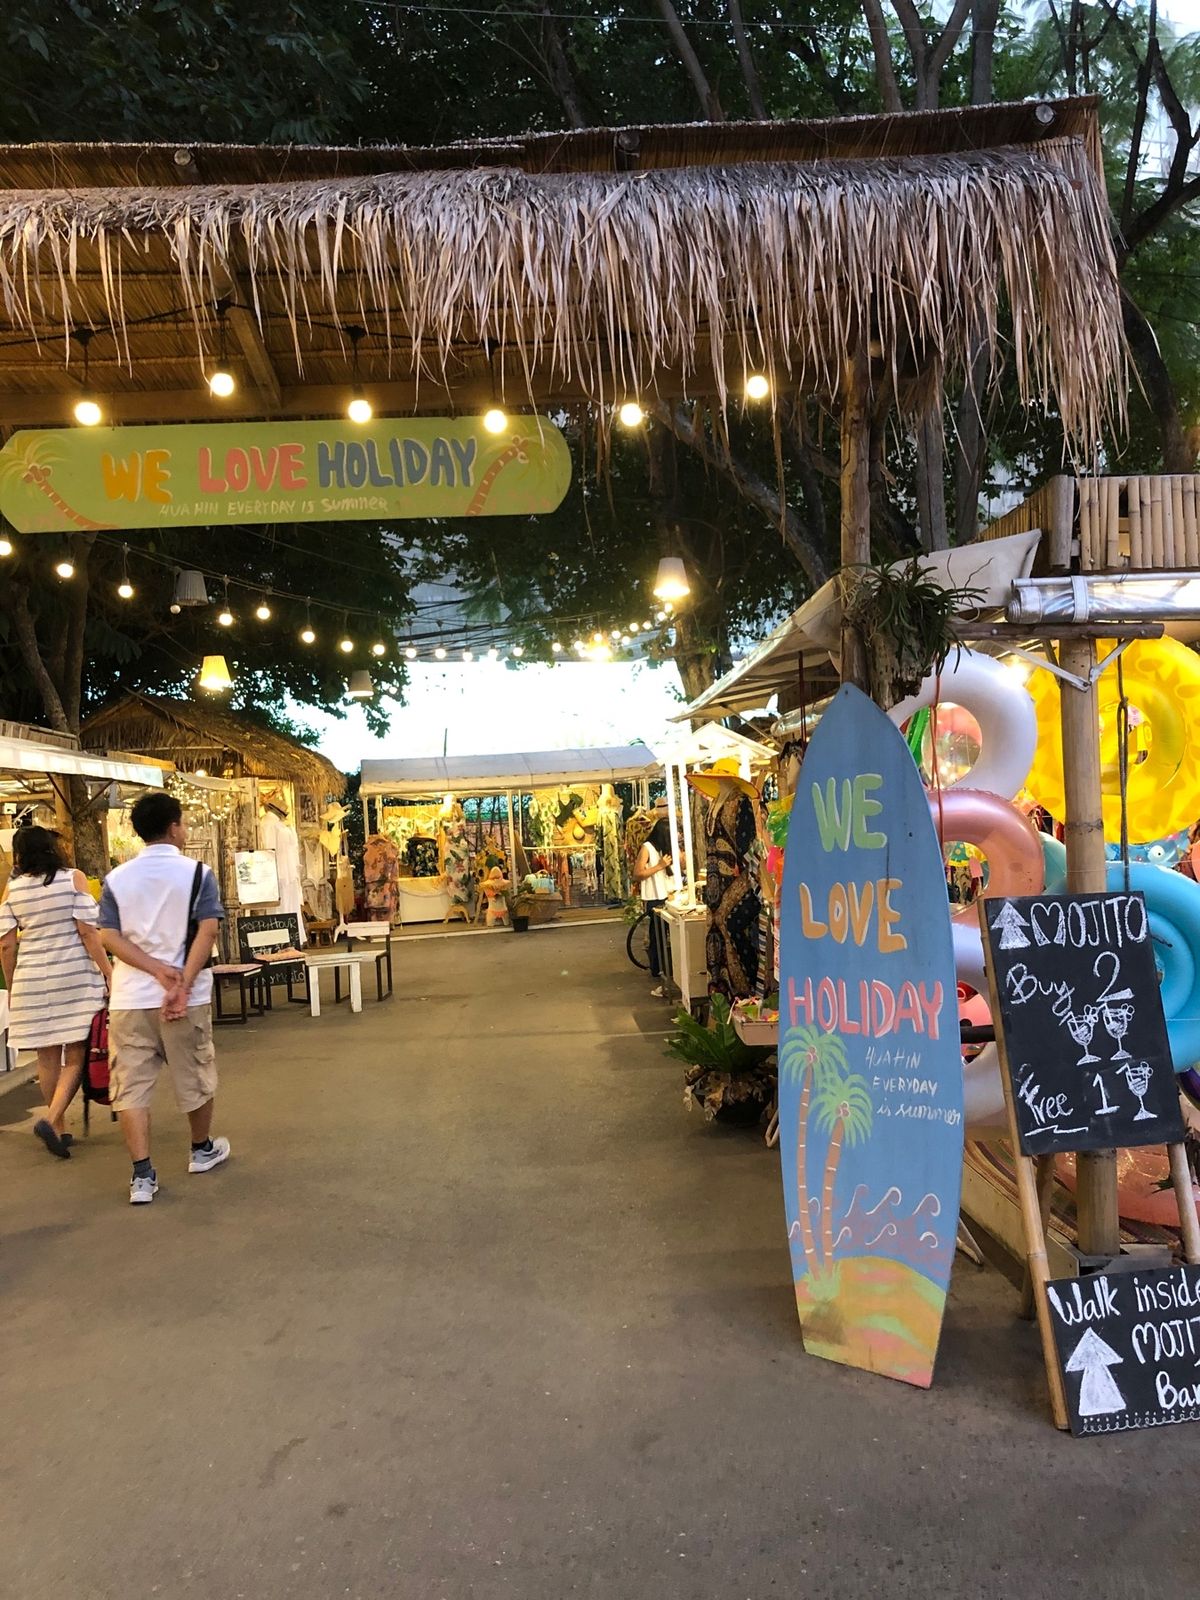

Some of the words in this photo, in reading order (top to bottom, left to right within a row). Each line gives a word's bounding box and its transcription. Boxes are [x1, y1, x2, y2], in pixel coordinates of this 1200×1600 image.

[101, 449, 173, 504] WE
[198, 443, 308, 493] LOVE
[318, 437, 477, 489] HOLIDAY
[227, 500, 295, 517] EVERYDAY
[812, 773, 887, 852] WE
[800, 878, 907, 953] LOVE
[1030, 895, 1148, 948] MOJITO
[788, 976, 943, 1040] HOLIDAY
[1006, 963, 1075, 1016] Buy
[1093, 951, 1134, 1003] 2
[873, 1075, 938, 1097] EVERYDAY
[876, 1097, 892, 1117] is
[1017, 1063, 1074, 1125] Free
[1093, 1073, 1120, 1115] 1
[1047, 1276, 1121, 1326] Walk
